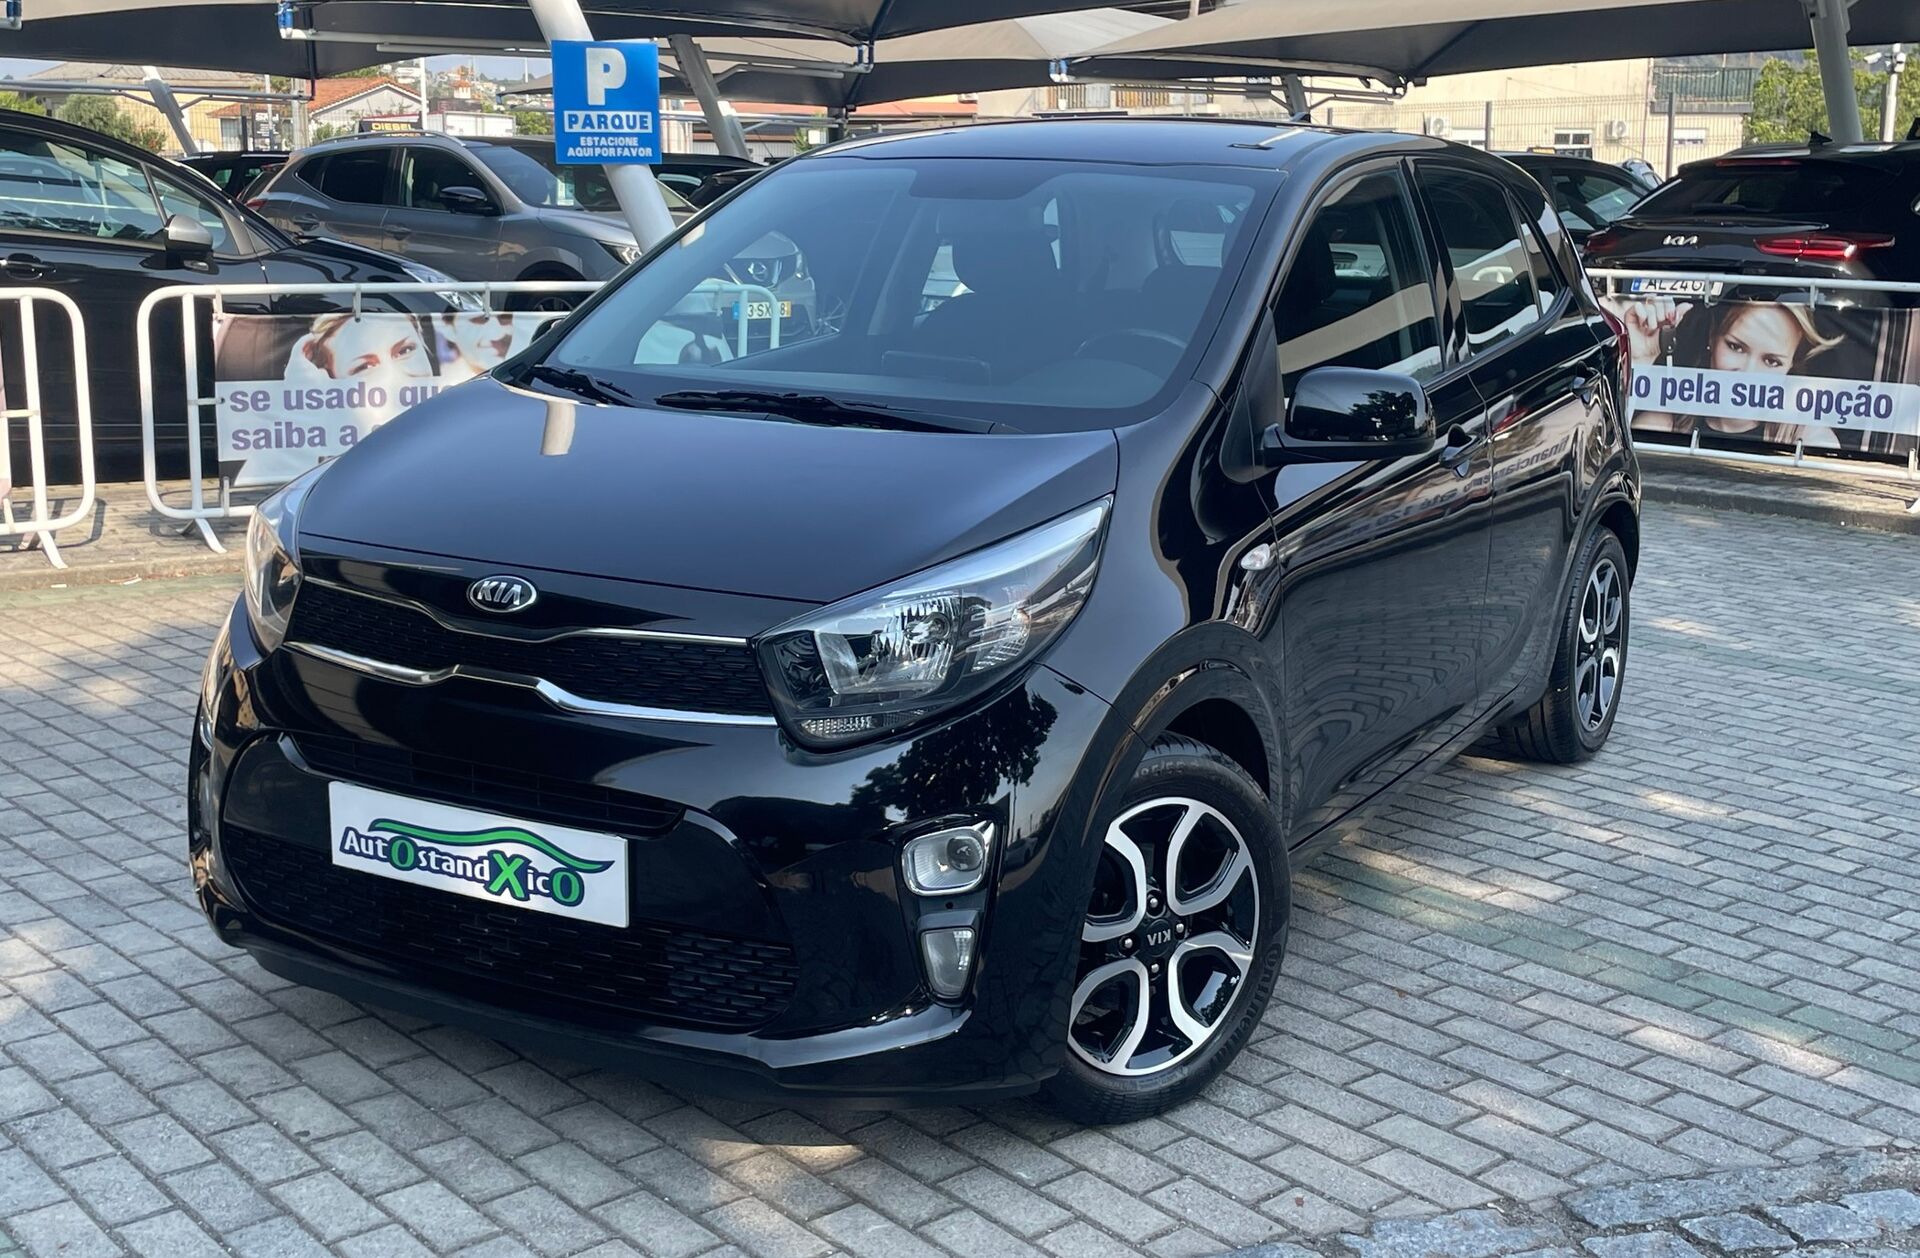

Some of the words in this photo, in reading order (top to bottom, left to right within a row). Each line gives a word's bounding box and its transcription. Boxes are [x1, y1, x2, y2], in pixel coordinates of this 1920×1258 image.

[586, 47, 627, 106] P
[371, 122, 415, 131] DIESEL
[567, 114, 649, 130] PARQUE
[580, 136, 639, 147] ESTACIONE
[567, 147, 594, 157] AQUI
[595, 147, 616, 157] POR
[616, 147, 653, 157] FAVOR
[1662, 235, 1698, 246] KIA
[229, 388, 271, 412] se
[283, 381, 387, 411] usado
[399, 384, 455, 408] qu
[1660, 373, 1721, 406] pela
[1731, 382, 1784, 410] sua
[1796, 384, 1893, 424] opção
[231, 421, 327, 450] saiba
[339, 424, 359, 446] a
[476, 580, 522, 606] KIA
[1146, 929, 1171, 946] KIA
